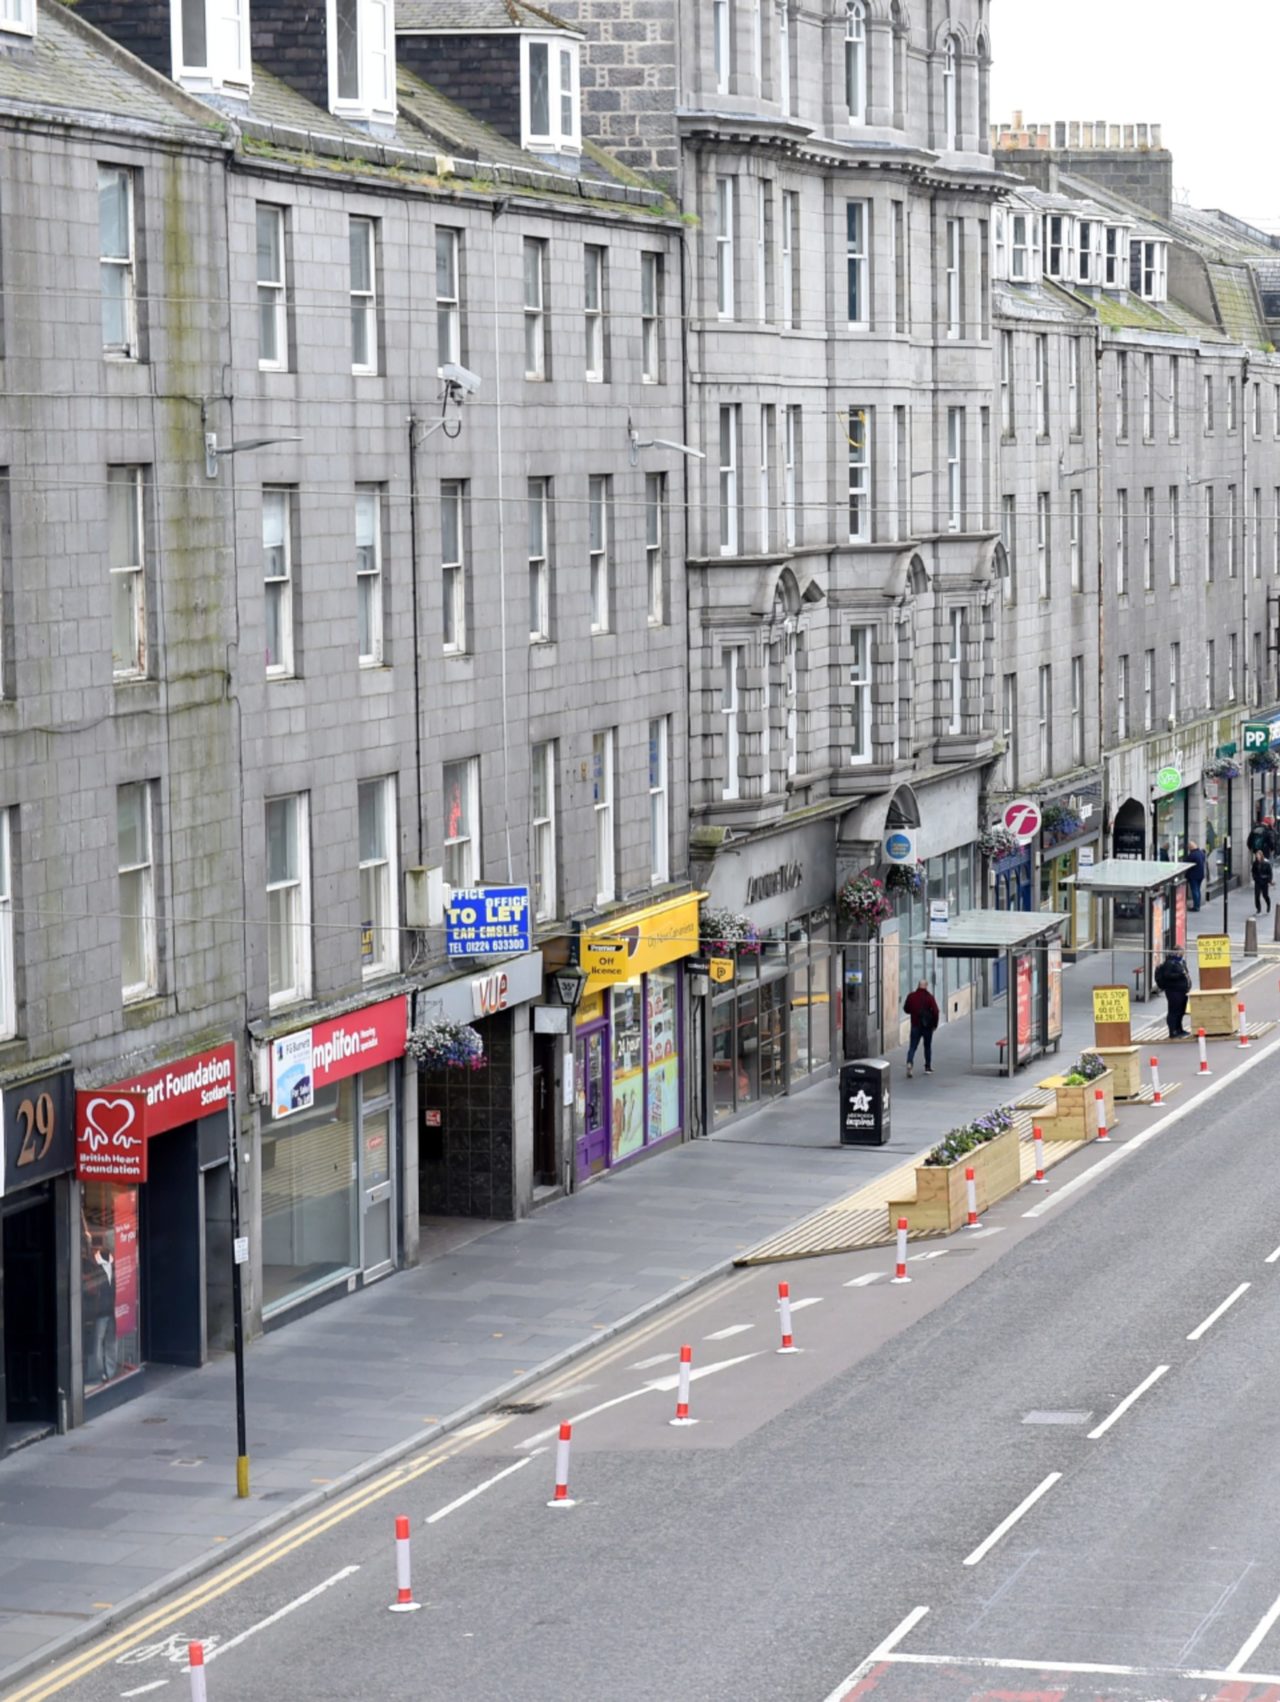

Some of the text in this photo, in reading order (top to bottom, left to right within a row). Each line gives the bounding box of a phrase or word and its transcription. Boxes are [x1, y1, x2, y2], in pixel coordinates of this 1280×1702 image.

[1246, 731, 1266, 747] PP
[448, 905, 524, 924] TO LET
[449, 942, 463, 953] TEL
[466, 941, 490, 952] 01224
[599, 957, 615, 966] Off
[591, 966, 622, 975] licence
[313, 1028, 360, 1072] mplifon
[166, 1058, 230, 1098] Foundation
[201, 1082, 231, 1106] Scotland
[16, 1092, 55, 1168] 29
[80, 1153, 140, 1164] British Heart
[80, 1164, 140, 1176] Foundation
